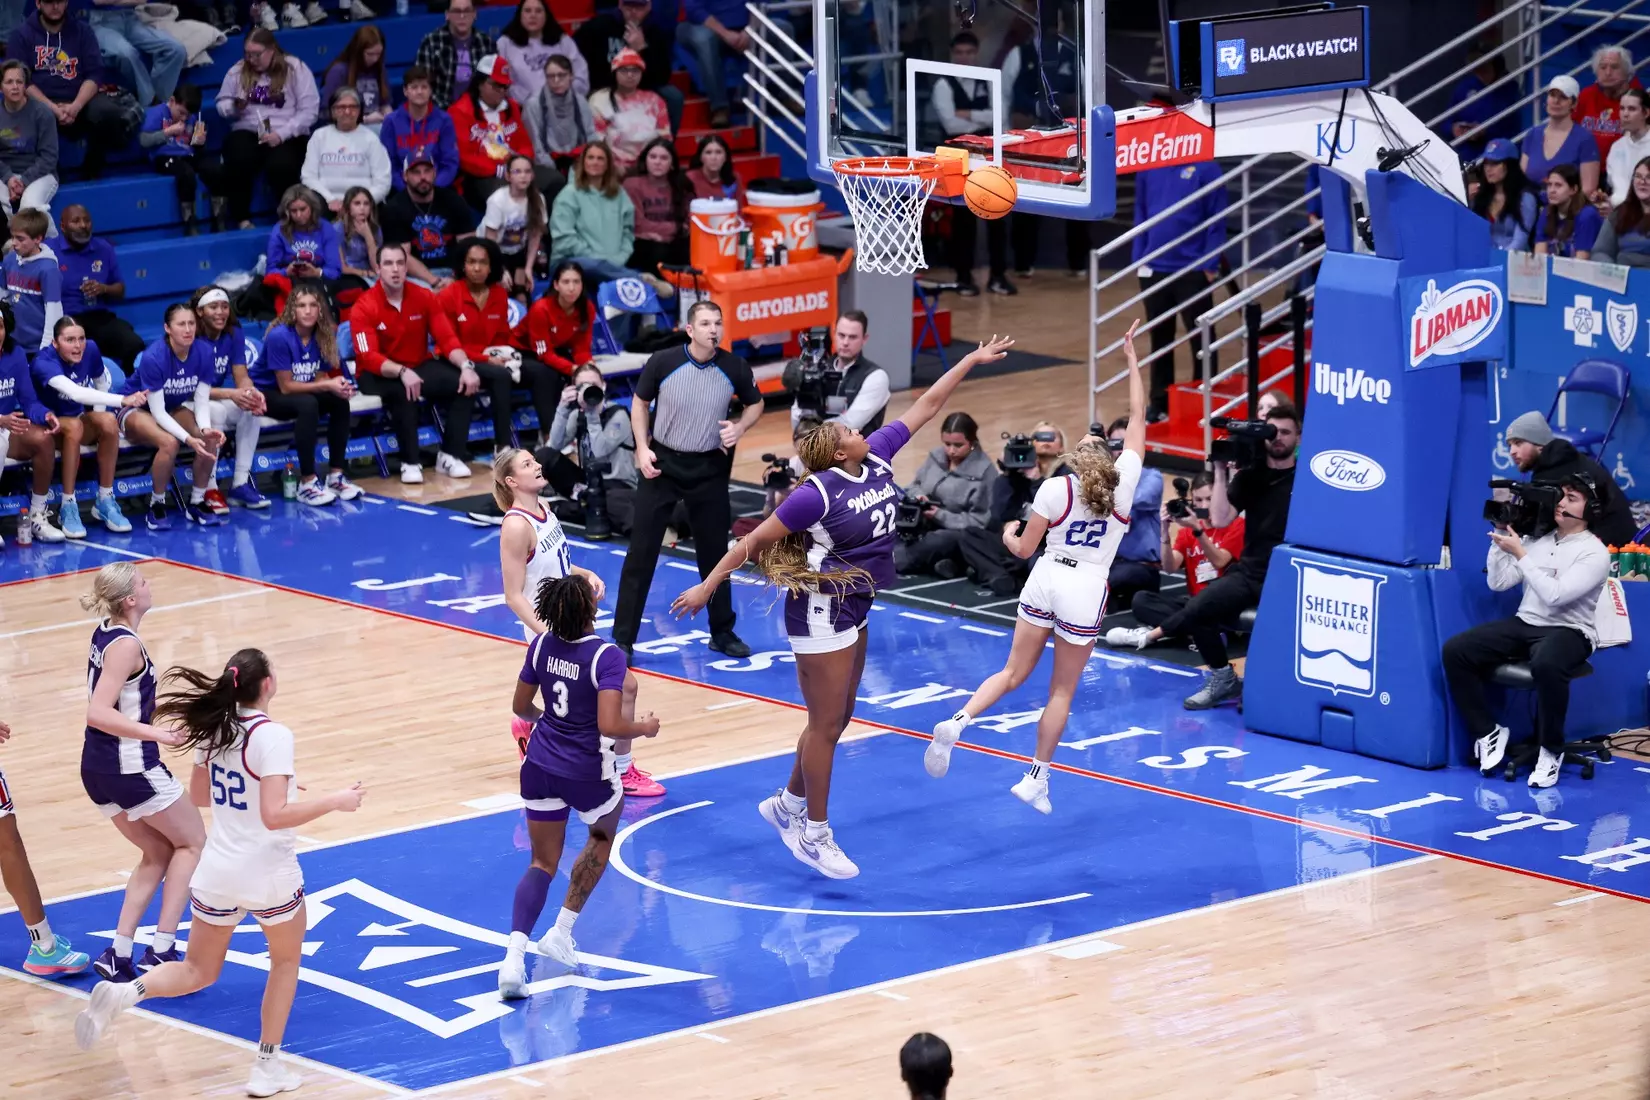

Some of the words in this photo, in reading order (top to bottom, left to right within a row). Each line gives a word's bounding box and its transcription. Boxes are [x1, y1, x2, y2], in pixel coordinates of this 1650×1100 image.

[1116, 137, 1150, 168] ate
[1315, 118, 1356, 160] KU
[793, 216, 810, 237] G
[736, 291, 829, 321] GATORADE
[1414, 292, 1491, 358] LIBMAN
[163, 375, 199, 389] ANSAS
[1324, 455, 1370, 485] Ford
[870, 503, 896, 538] 22
[1065, 519, 1108, 549] 22
[1305, 594, 1369, 622] SHELTER
[1608, 579, 1628, 617] LIBMAN
[1304, 612, 1368, 635] INSURANCE
[546, 655, 580, 681] HARROD
[552, 680, 569, 718] 3
[211, 762, 248, 811] 52
